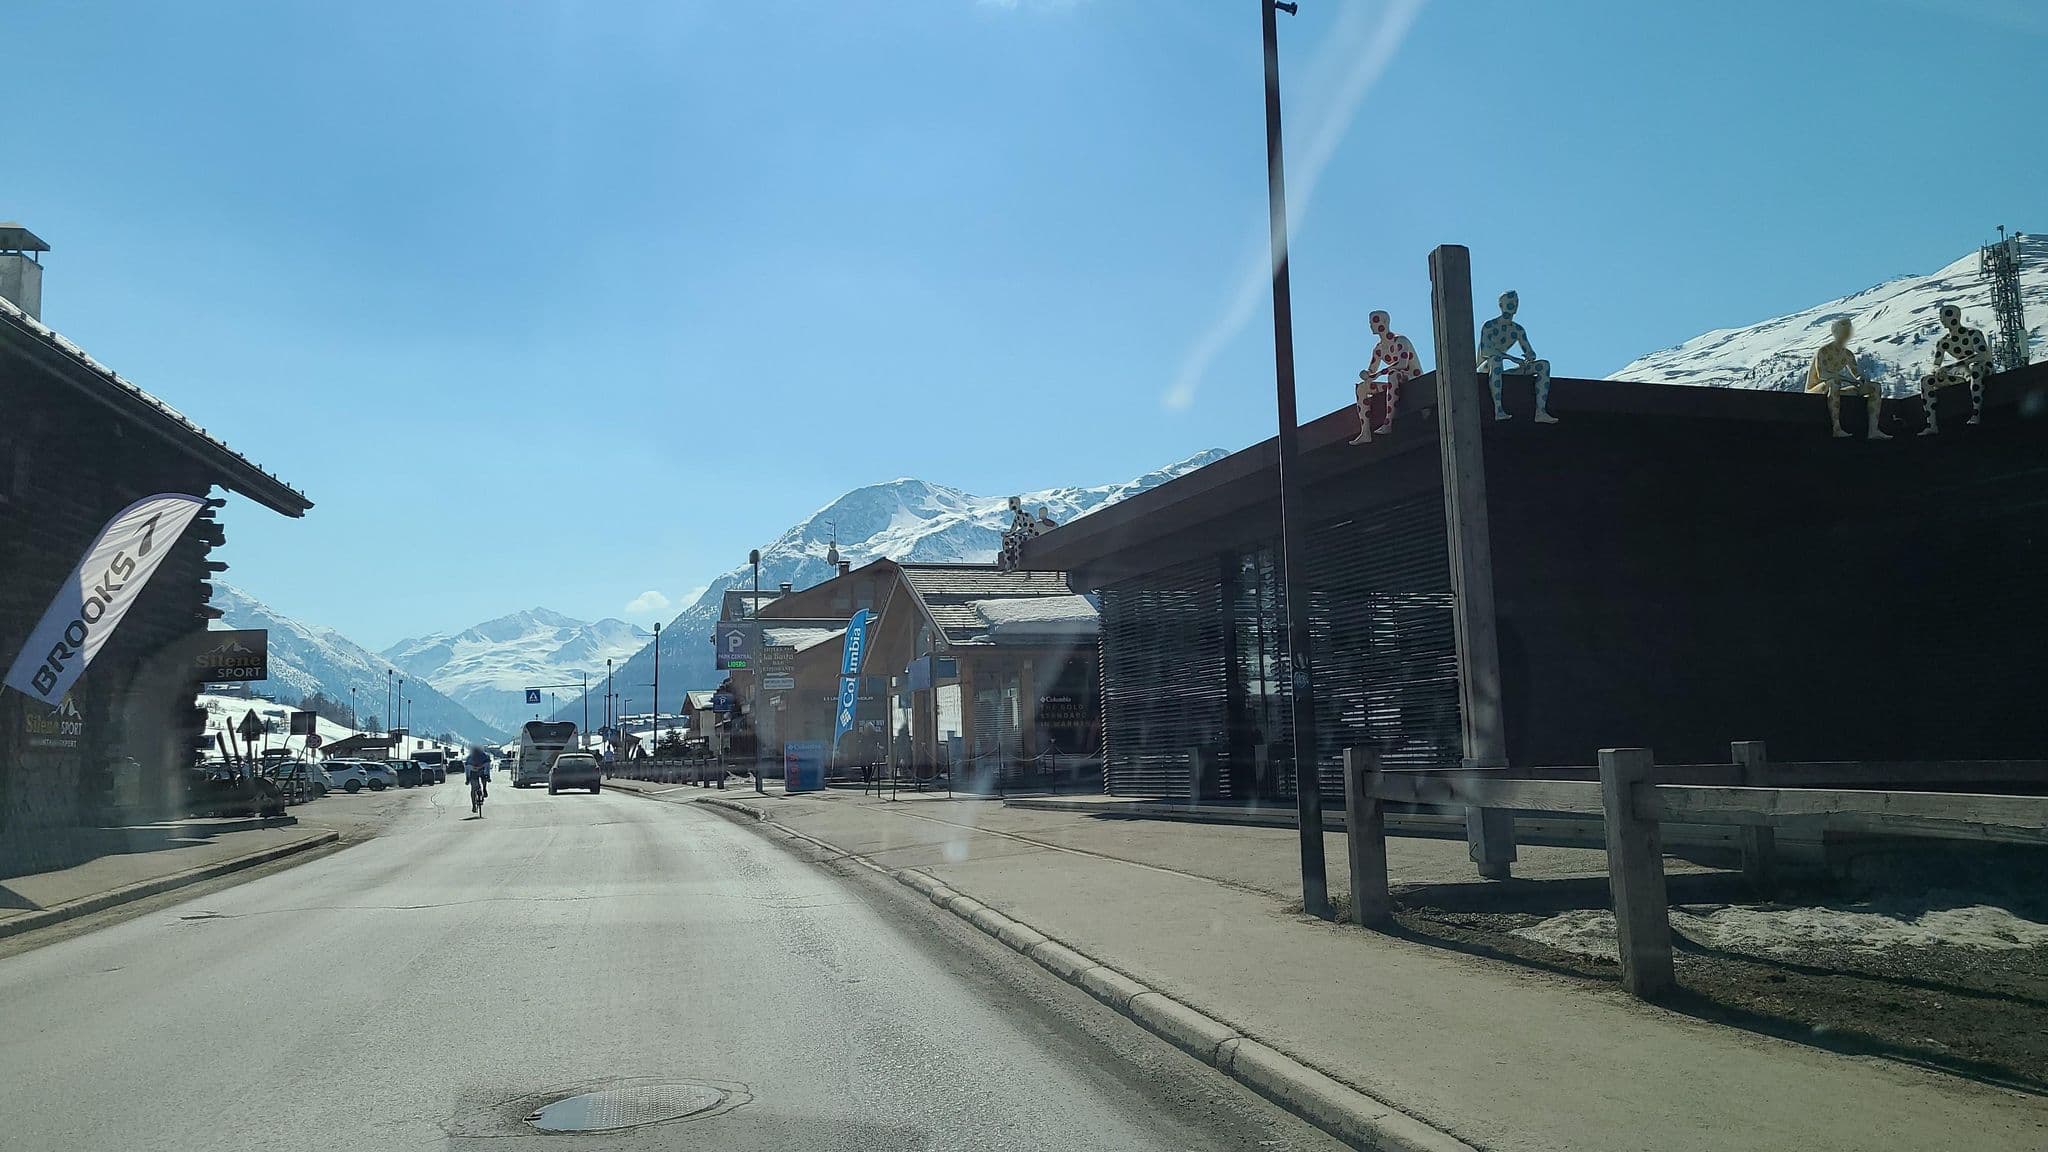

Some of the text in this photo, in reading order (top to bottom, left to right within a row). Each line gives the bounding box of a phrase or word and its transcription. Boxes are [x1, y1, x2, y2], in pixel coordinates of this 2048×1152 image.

[31, 551, 136, 696] BROOKS
[728, 636, 743, 653] P
[217, 666, 262, 679] SPORT
[61, 721, 82, 736] SPORT
